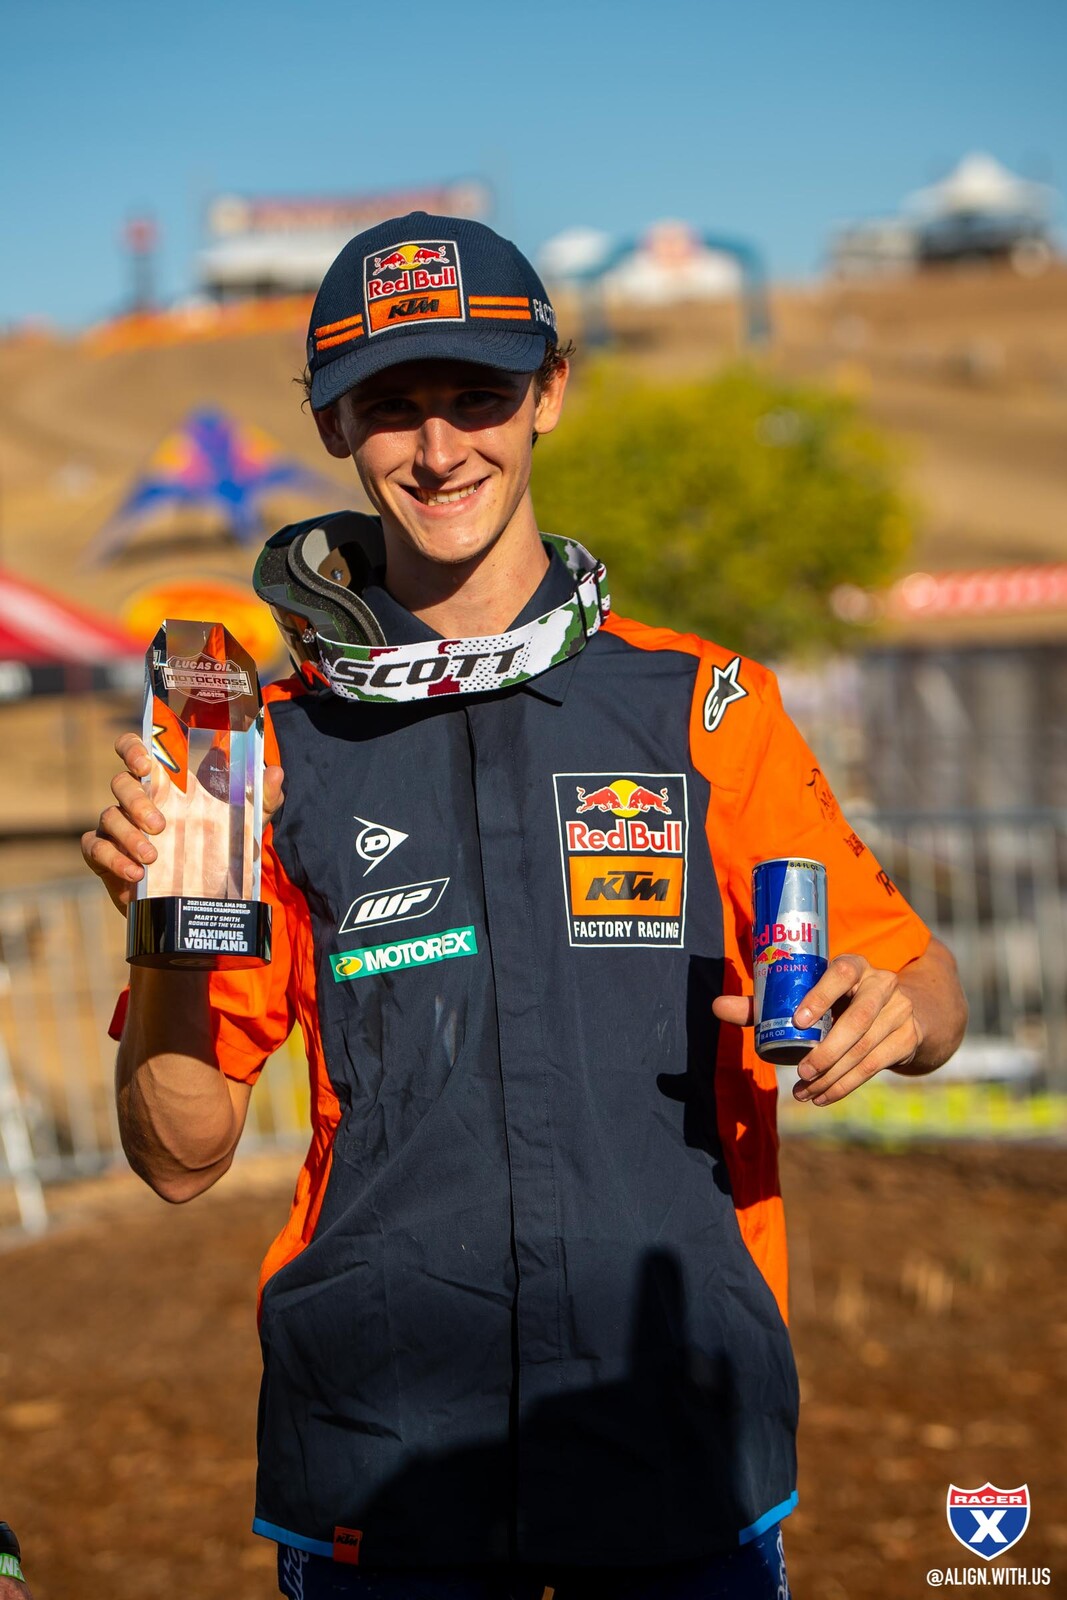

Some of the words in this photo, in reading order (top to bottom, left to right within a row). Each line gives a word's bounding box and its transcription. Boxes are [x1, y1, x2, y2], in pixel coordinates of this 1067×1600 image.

[368, 276, 409, 300] Red
[412, 266, 457, 290] Bull
[388, 297, 439, 319] KTM
[174, 660, 211, 671] LUCAS
[214, 663, 232, 672] OIL
[331, 643, 525, 688] SCOTT
[166, 674, 247, 686] MOTOCROSS
[567, 820, 627, 850] Red
[628, 820, 682, 853] Bull
[585, 871, 670, 901] KTM
[354, 888, 432, 924] WP
[188, 928, 244, 940] MAXIMUS
[573, 921, 632, 938] FACTORY
[638, 921, 679, 938] RACING
[772, 923, 813, 943] Bull
[184, 937, 248, 952] VOHLAND
[364, 931, 472, 971] MOTOREX
[776, 964, 808, 972] DRINK
